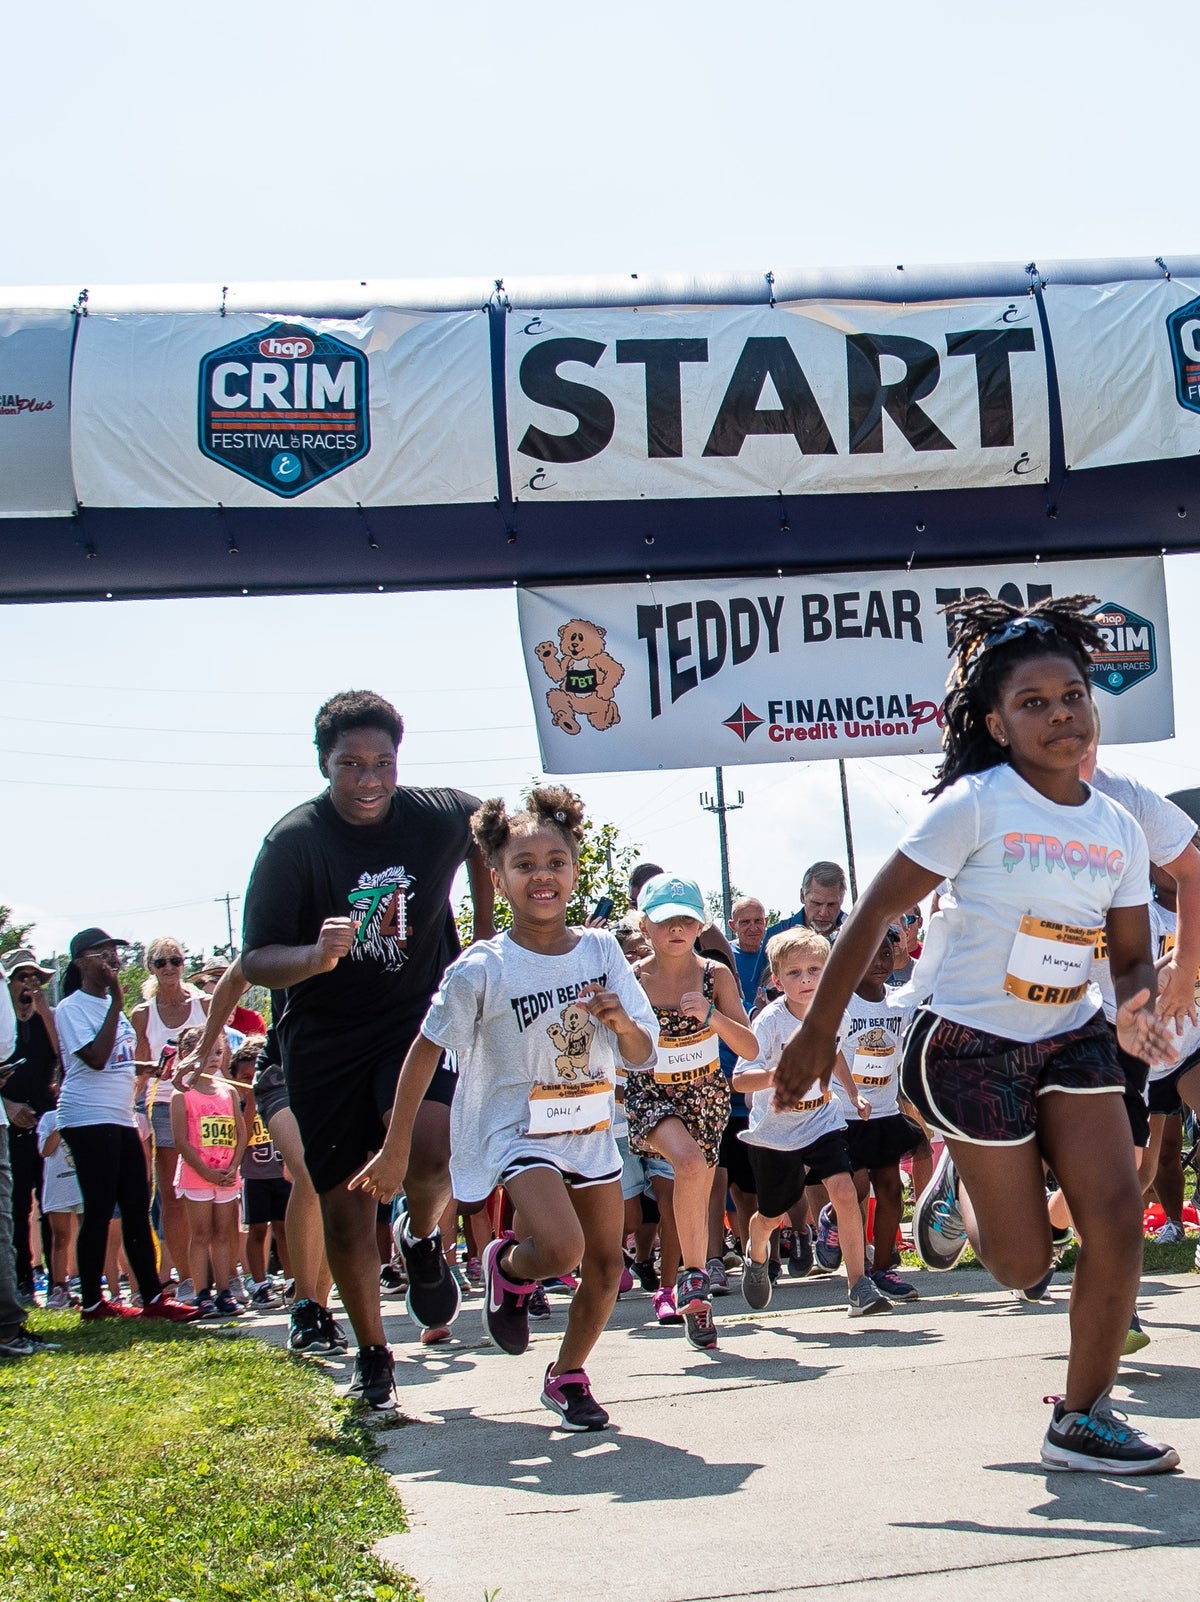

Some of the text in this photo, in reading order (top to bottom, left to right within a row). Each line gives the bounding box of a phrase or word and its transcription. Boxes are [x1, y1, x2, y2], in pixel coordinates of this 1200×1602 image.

[269, 338, 308, 357] hap
[211, 361, 356, 410] CRIM
[516, 327, 1036, 464] START
[211, 433, 290, 449] FESTIVAL
[302, 434, 357, 450] RACES
[1097, 626, 1149, 651] RIM
[637, 595, 785, 720] TEDDY
[801, 588, 925, 644] BEAR
[1089, 663, 1117, 672] STIVAL
[1123, 662, 1151, 671] RACES
[570, 675, 594, 688] TBT
[768, 693, 923, 724] FINANCIAL
[768, 719, 909, 742] Credit Union
[1003, 832, 1125, 882] STRONG
[1040, 920, 1063, 930] CRIM
[510, 989, 554, 1033] TEDDY
[668, 1050, 704, 1065] EVELYN
[671, 1065, 710, 1082] CRIM
[542, 1083, 561, 1091] CRIM
[795, 1099, 825, 1110] CRIM
